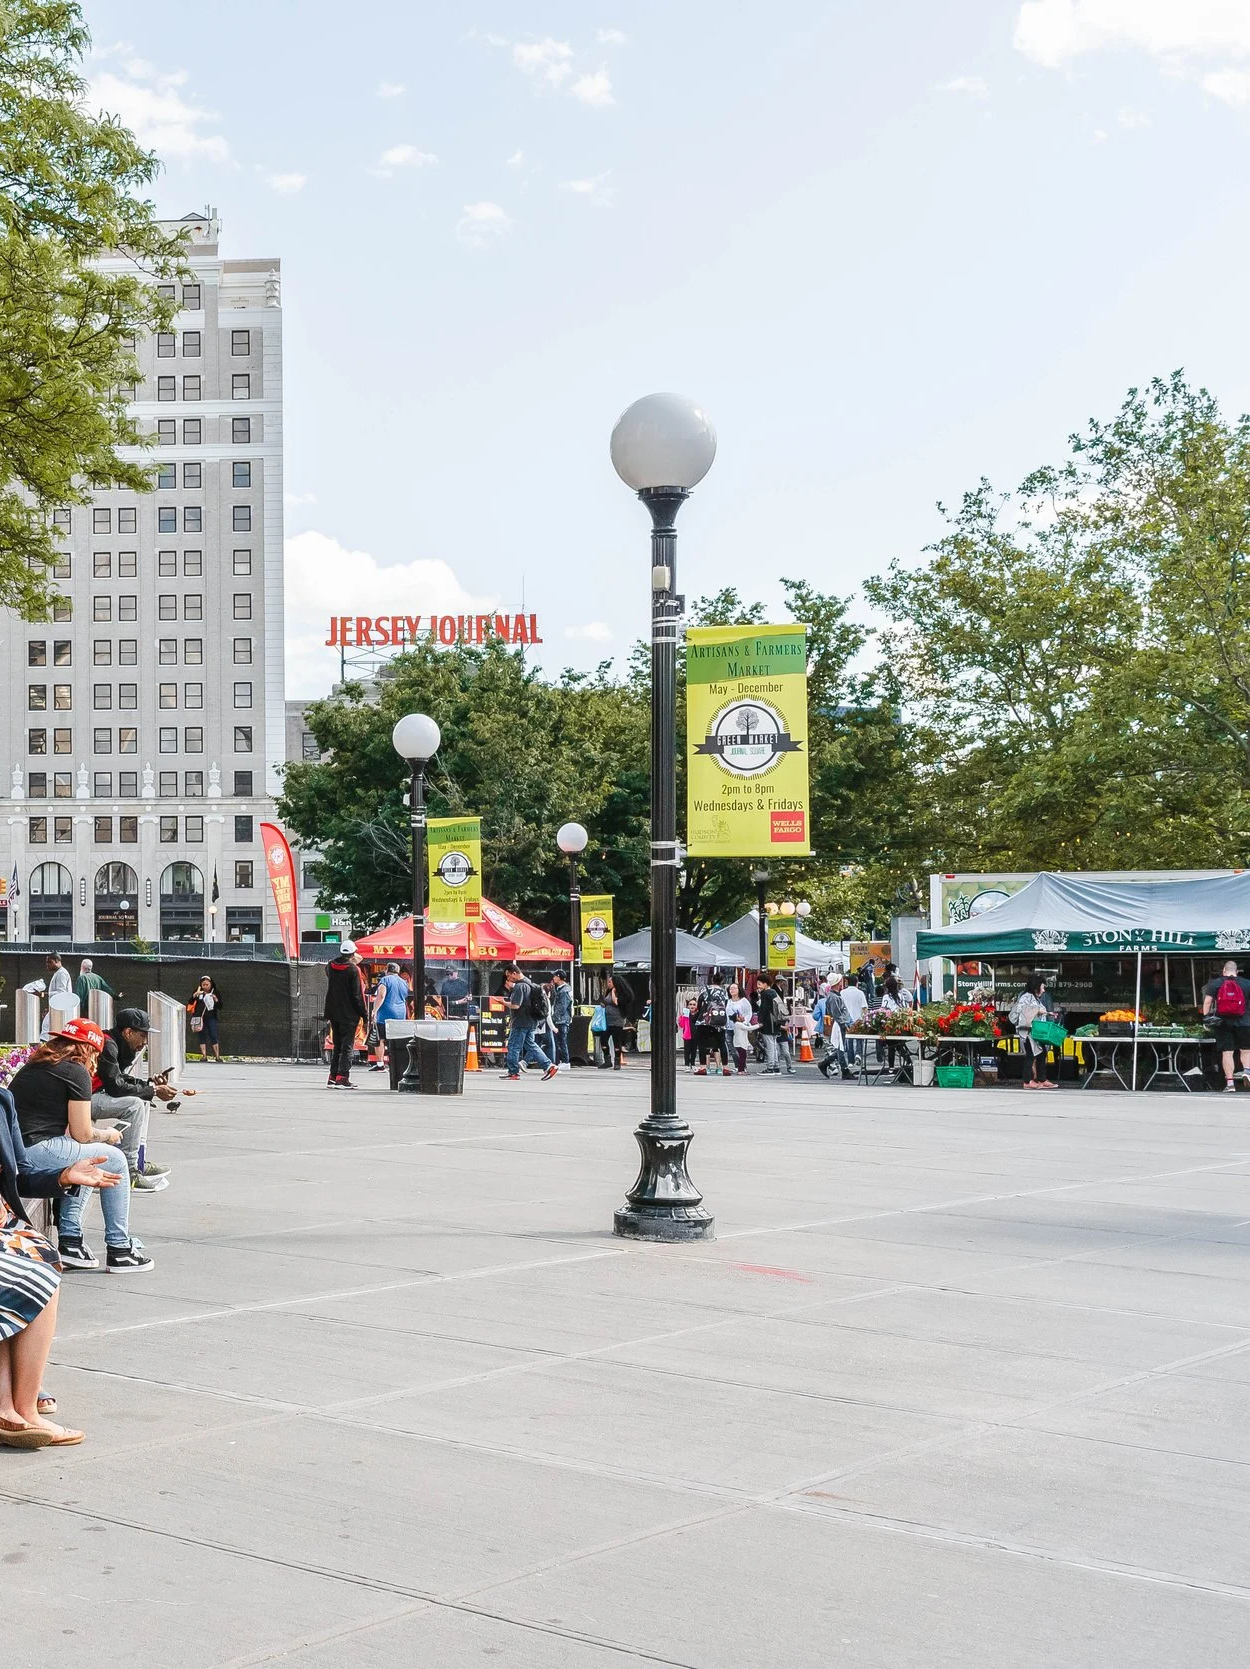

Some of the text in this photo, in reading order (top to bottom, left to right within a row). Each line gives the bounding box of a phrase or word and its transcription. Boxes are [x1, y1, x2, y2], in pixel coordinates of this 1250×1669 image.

[325, 613, 544, 647] JERSEY JOURNAL
[690, 640, 802, 659] ARTISANS & FARMERS
[727, 662, 771, 677] MARKET
[709, 683, 728, 696] May
[737, 682, 784, 694] December
[716, 734, 779, 746] GREEN MARKET
[721, 783, 775, 796] 2pm to 8pm
[693, 798, 804, 812] Wednesdays & Fridays
[373, 945, 499, 957] MY YMMY BQ
[87, 1030, 103, 1046] FAME
